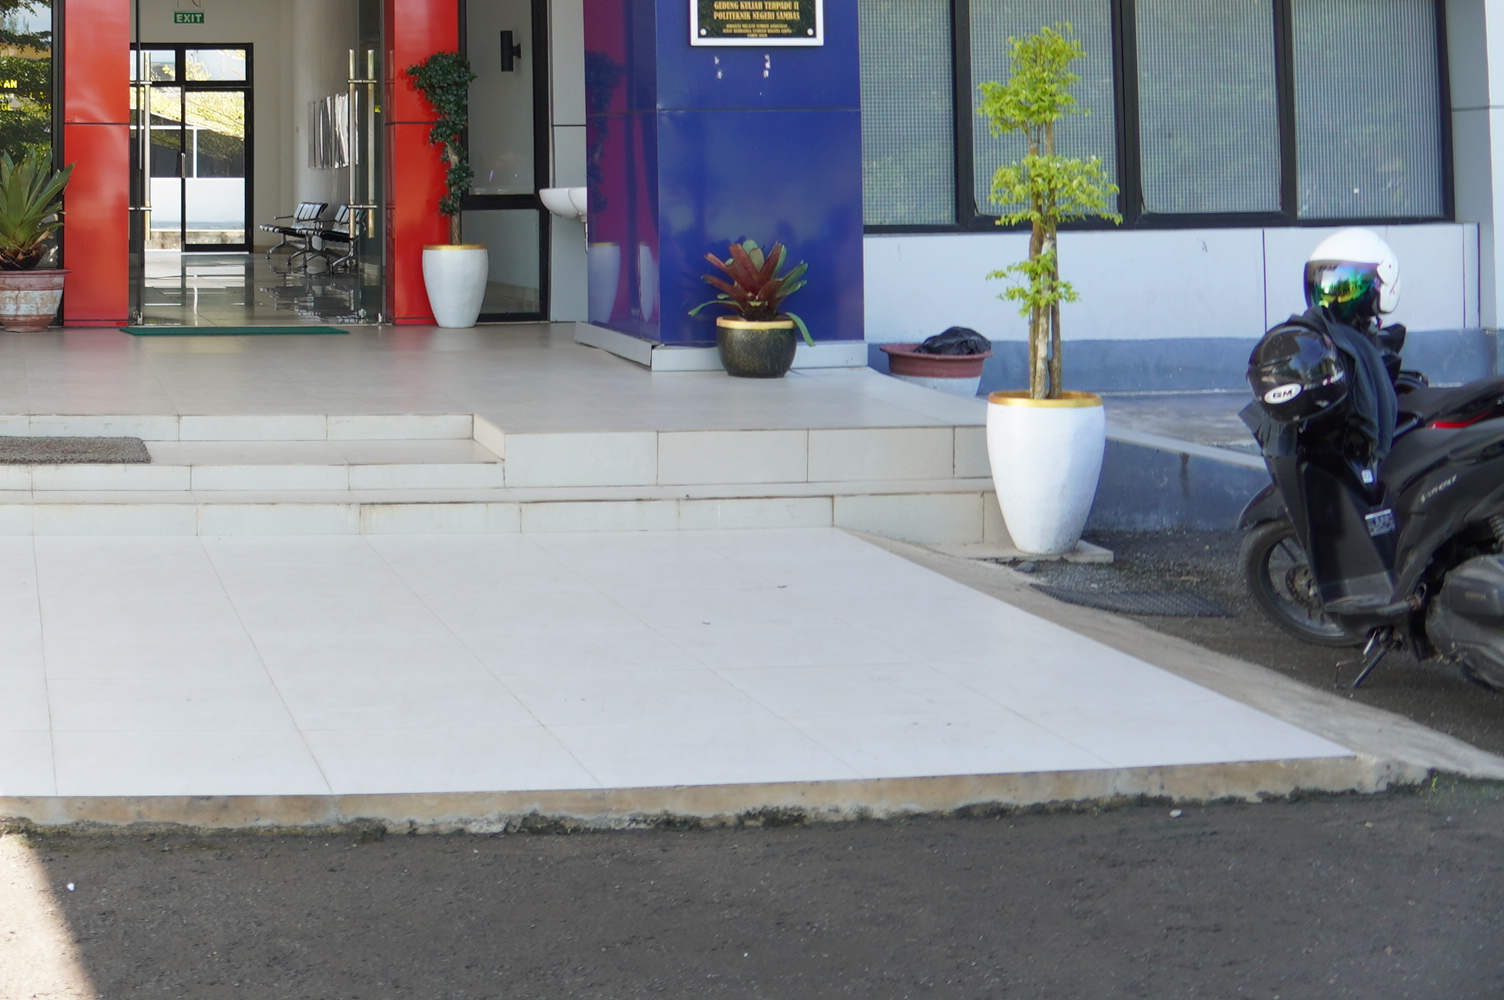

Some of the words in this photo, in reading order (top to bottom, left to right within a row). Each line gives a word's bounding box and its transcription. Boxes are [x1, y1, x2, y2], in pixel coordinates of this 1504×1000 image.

[713, 1, 739, 10] GEDUNG
[764, 1, 792, 11] TERPADU
[176, 14, 202, 23] EXIT
[713, 11, 752, 20] POLITEKNIK
[752, 11, 775, 20] NEGERI
[776, 11, 800, 21] SAMBAS
